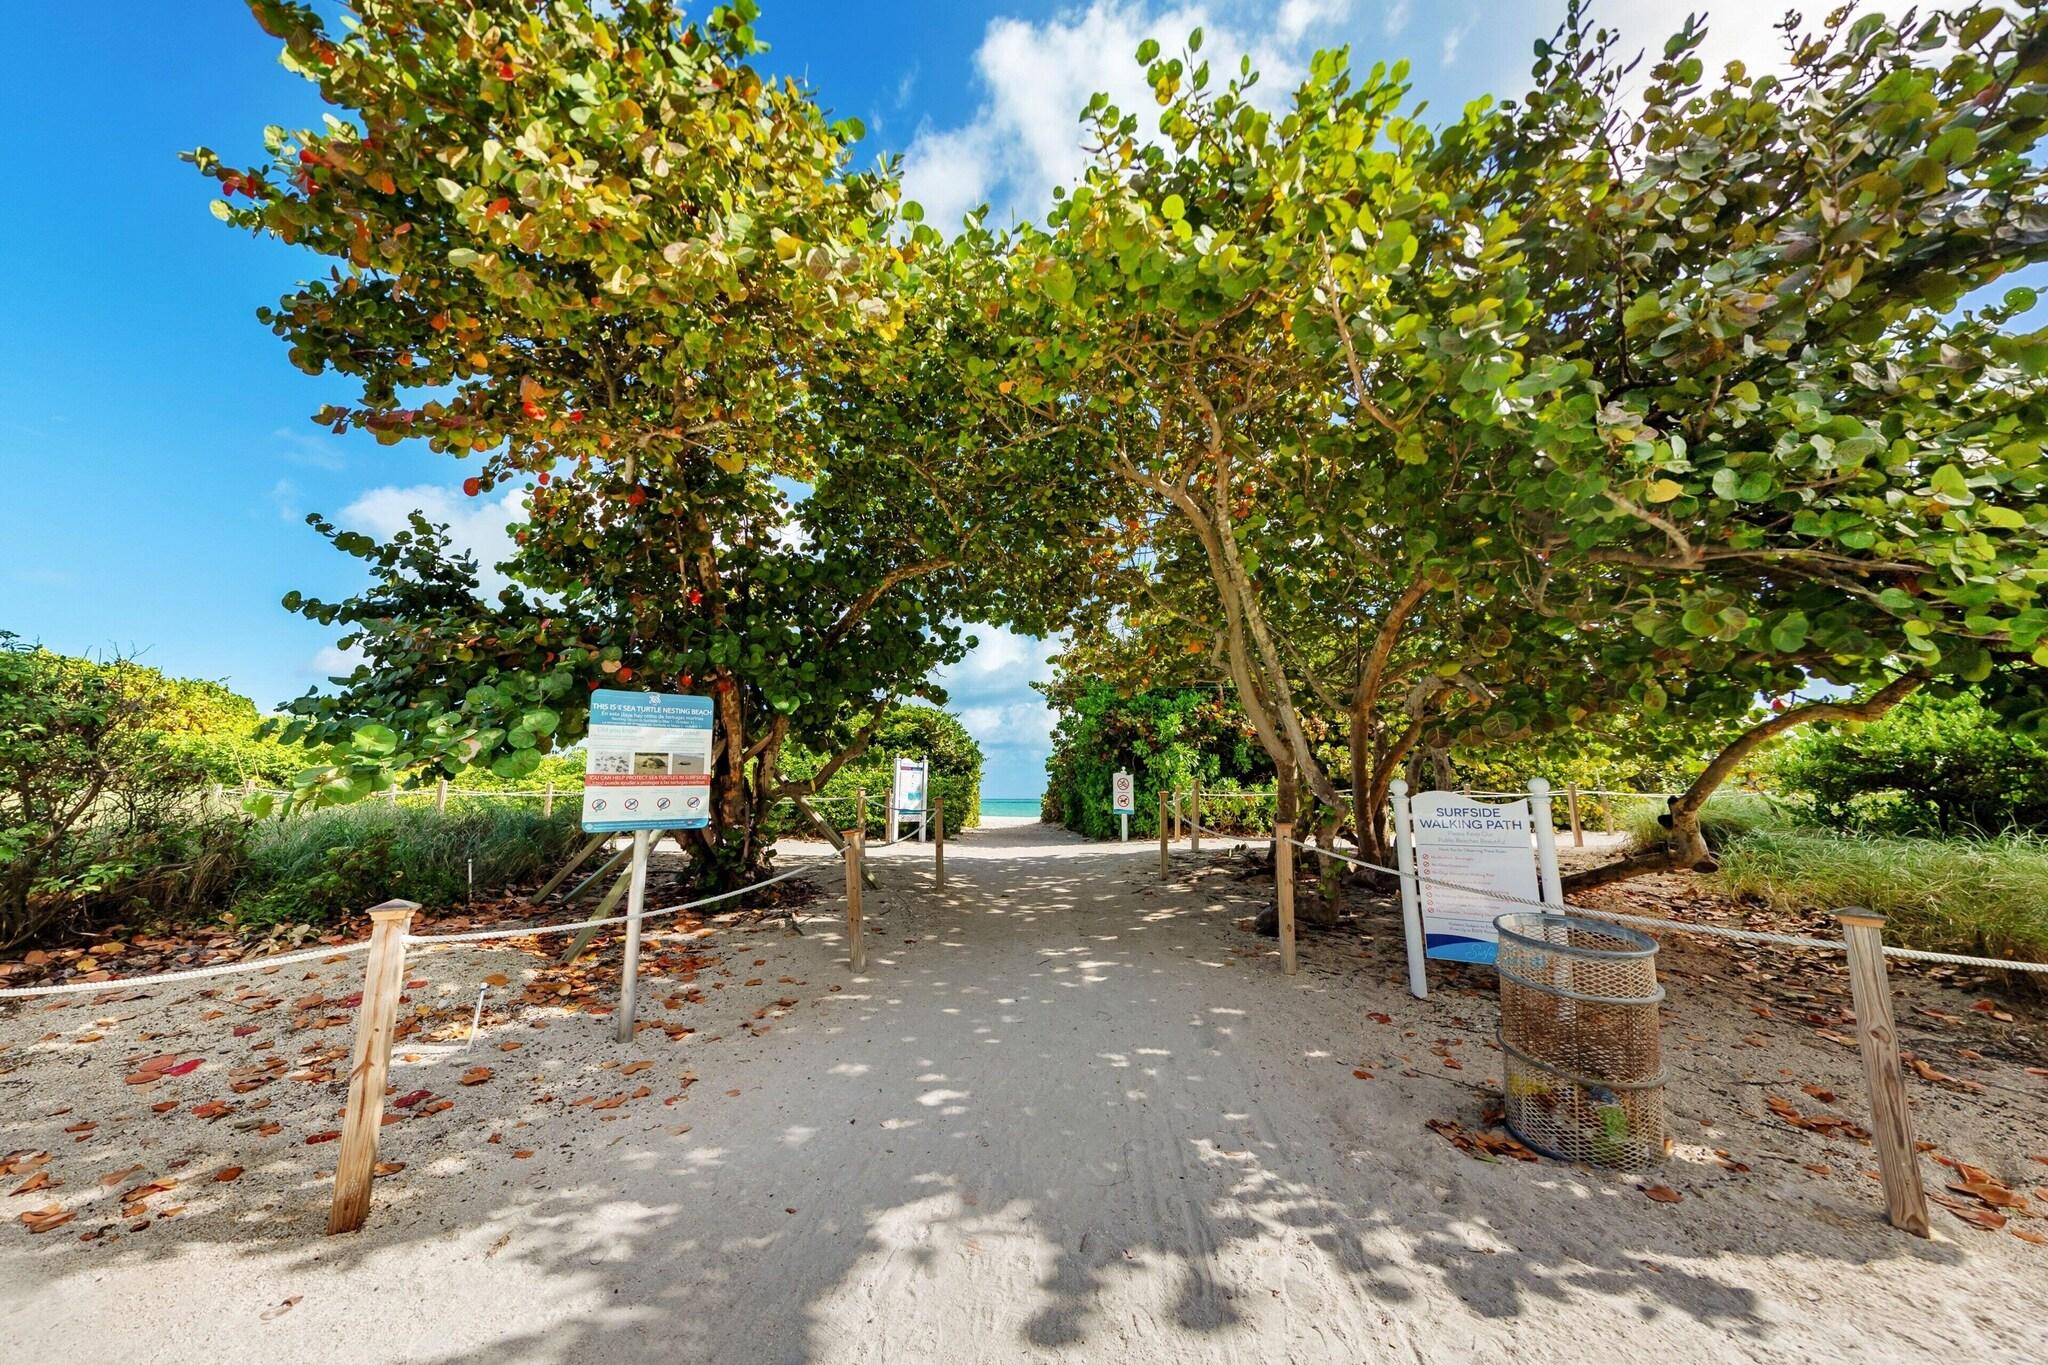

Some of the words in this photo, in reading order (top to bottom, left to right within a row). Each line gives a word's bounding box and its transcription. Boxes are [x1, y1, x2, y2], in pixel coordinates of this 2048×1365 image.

[609, 703, 617, 711] IS
[623, 704, 636, 712] SEA
[636, 705, 661, 714] TURTLE
[663, 707, 691, 715] NESTING
[691, 708, 712, 716] BEACH
[1436, 807, 1501, 818] SURFSIDE
[1420, 819, 1483, 829] WALKING
[1486, 819, 1523, 830] PATH
